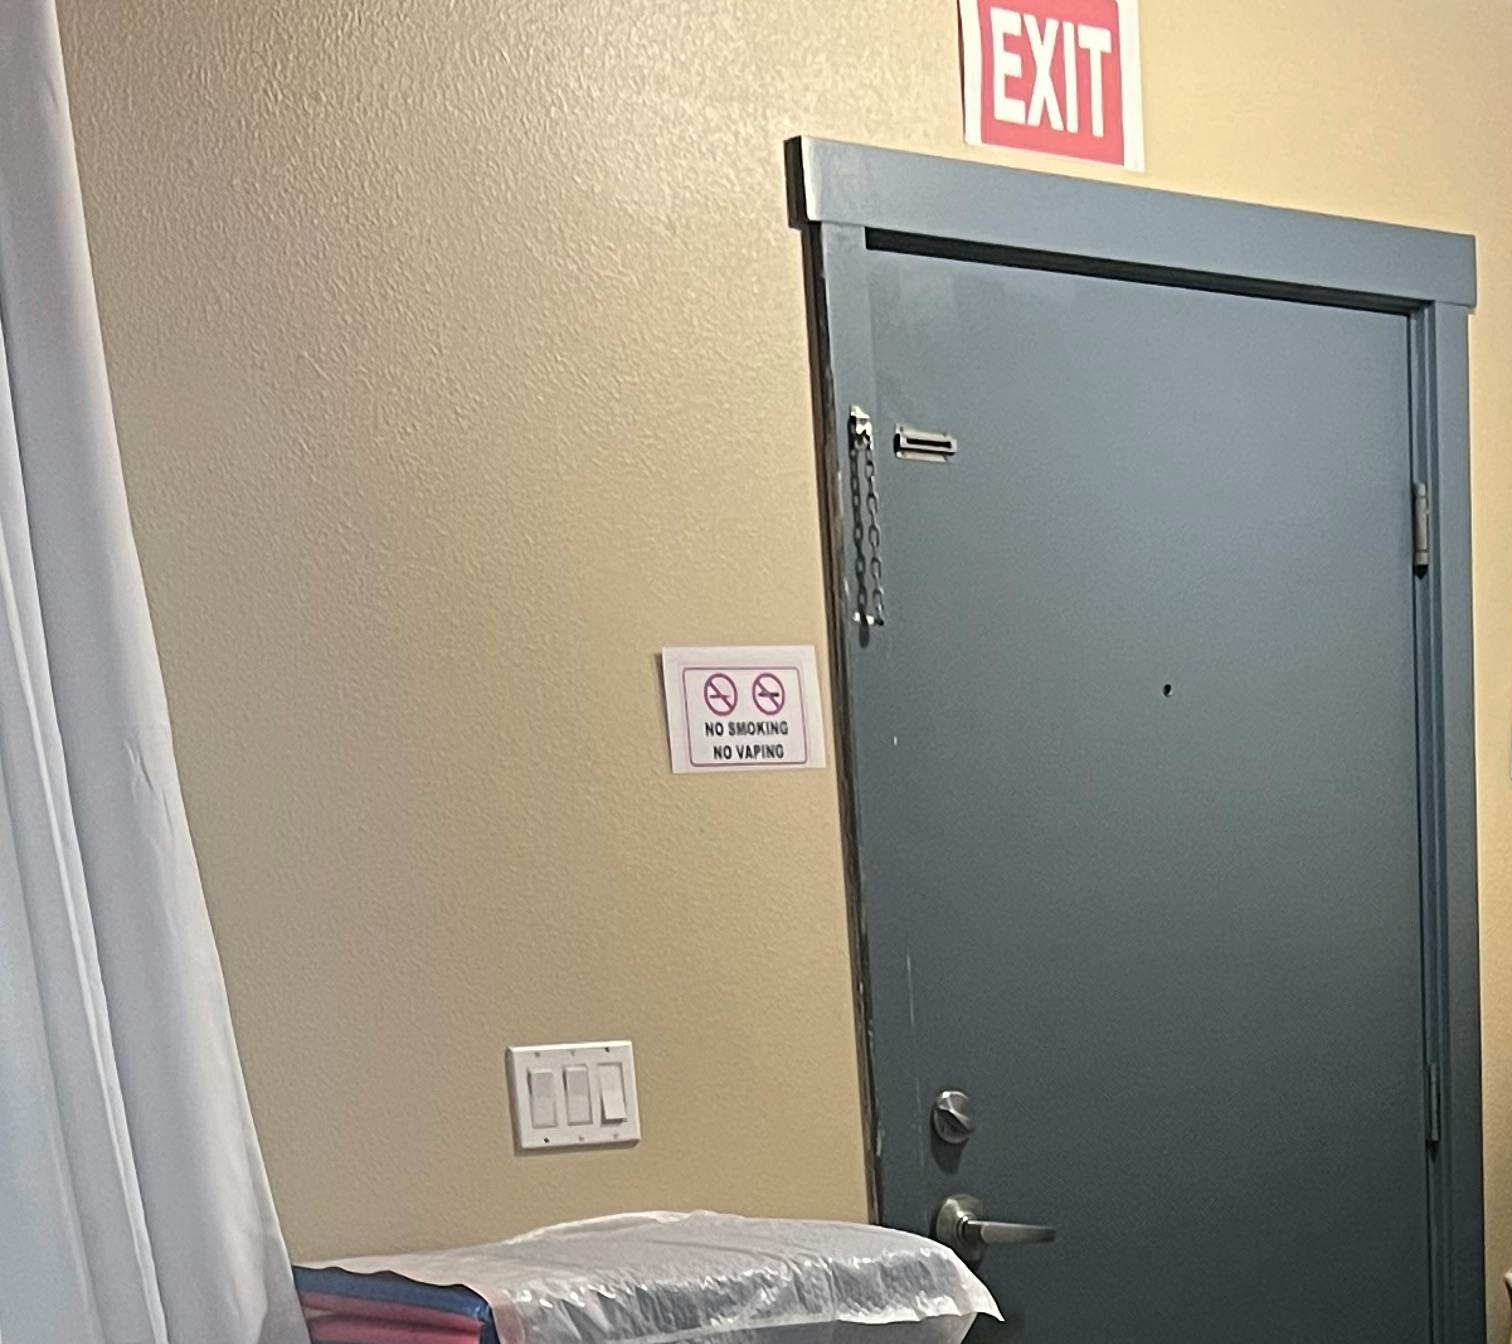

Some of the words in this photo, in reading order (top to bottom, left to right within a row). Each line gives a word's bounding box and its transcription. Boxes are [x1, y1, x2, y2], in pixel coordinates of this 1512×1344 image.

[990, 6, 1113, 139] EXIT
[704, 721, 724, 736] NO
[728, 720, 788, 736] SMOKING
[713, 745, 731, 760] NO
[735, 744, 784, 759] VAPING
